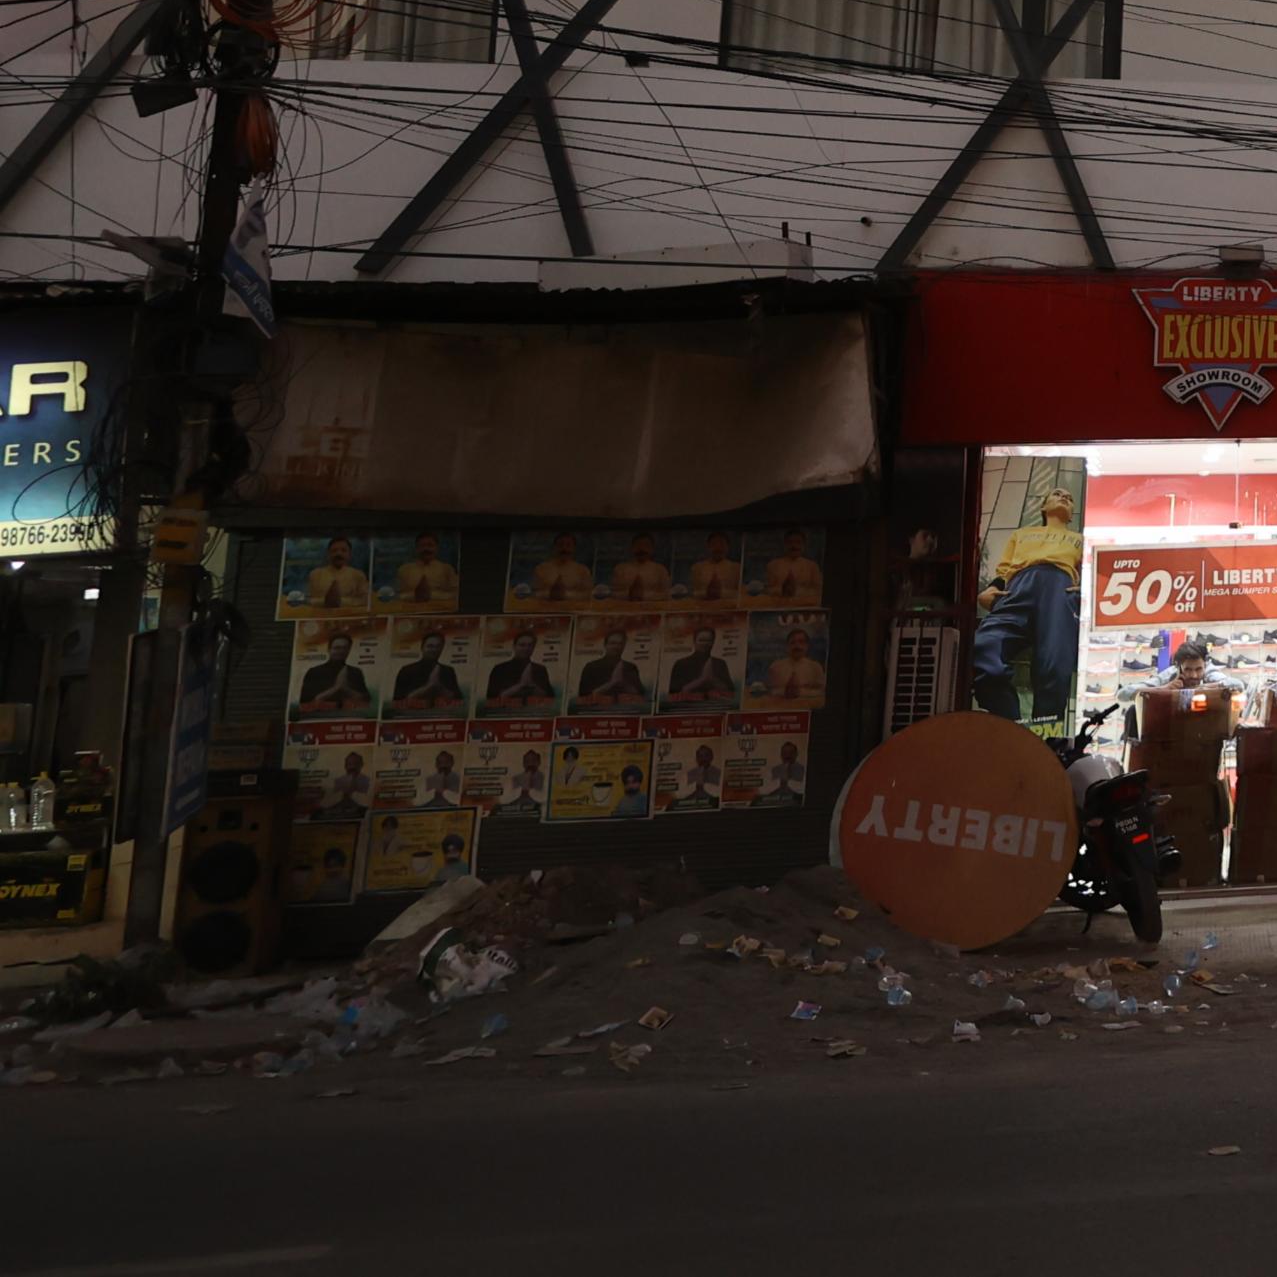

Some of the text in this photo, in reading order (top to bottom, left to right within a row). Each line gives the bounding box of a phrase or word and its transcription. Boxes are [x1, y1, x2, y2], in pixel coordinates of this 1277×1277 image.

[1183, 286, 1262, 301] LIBERTY
[1176, 370, 1263, 394] SHOWROOM
[1113, 559, 1141, 569] UPTO
[1099, 569, 1197, 616] 50%
[1204, 588, 1230, 597] MEGA
[1232, 587, 1271, 596] BUMPER
[855, 795, 1067, 862] LIBERTY
